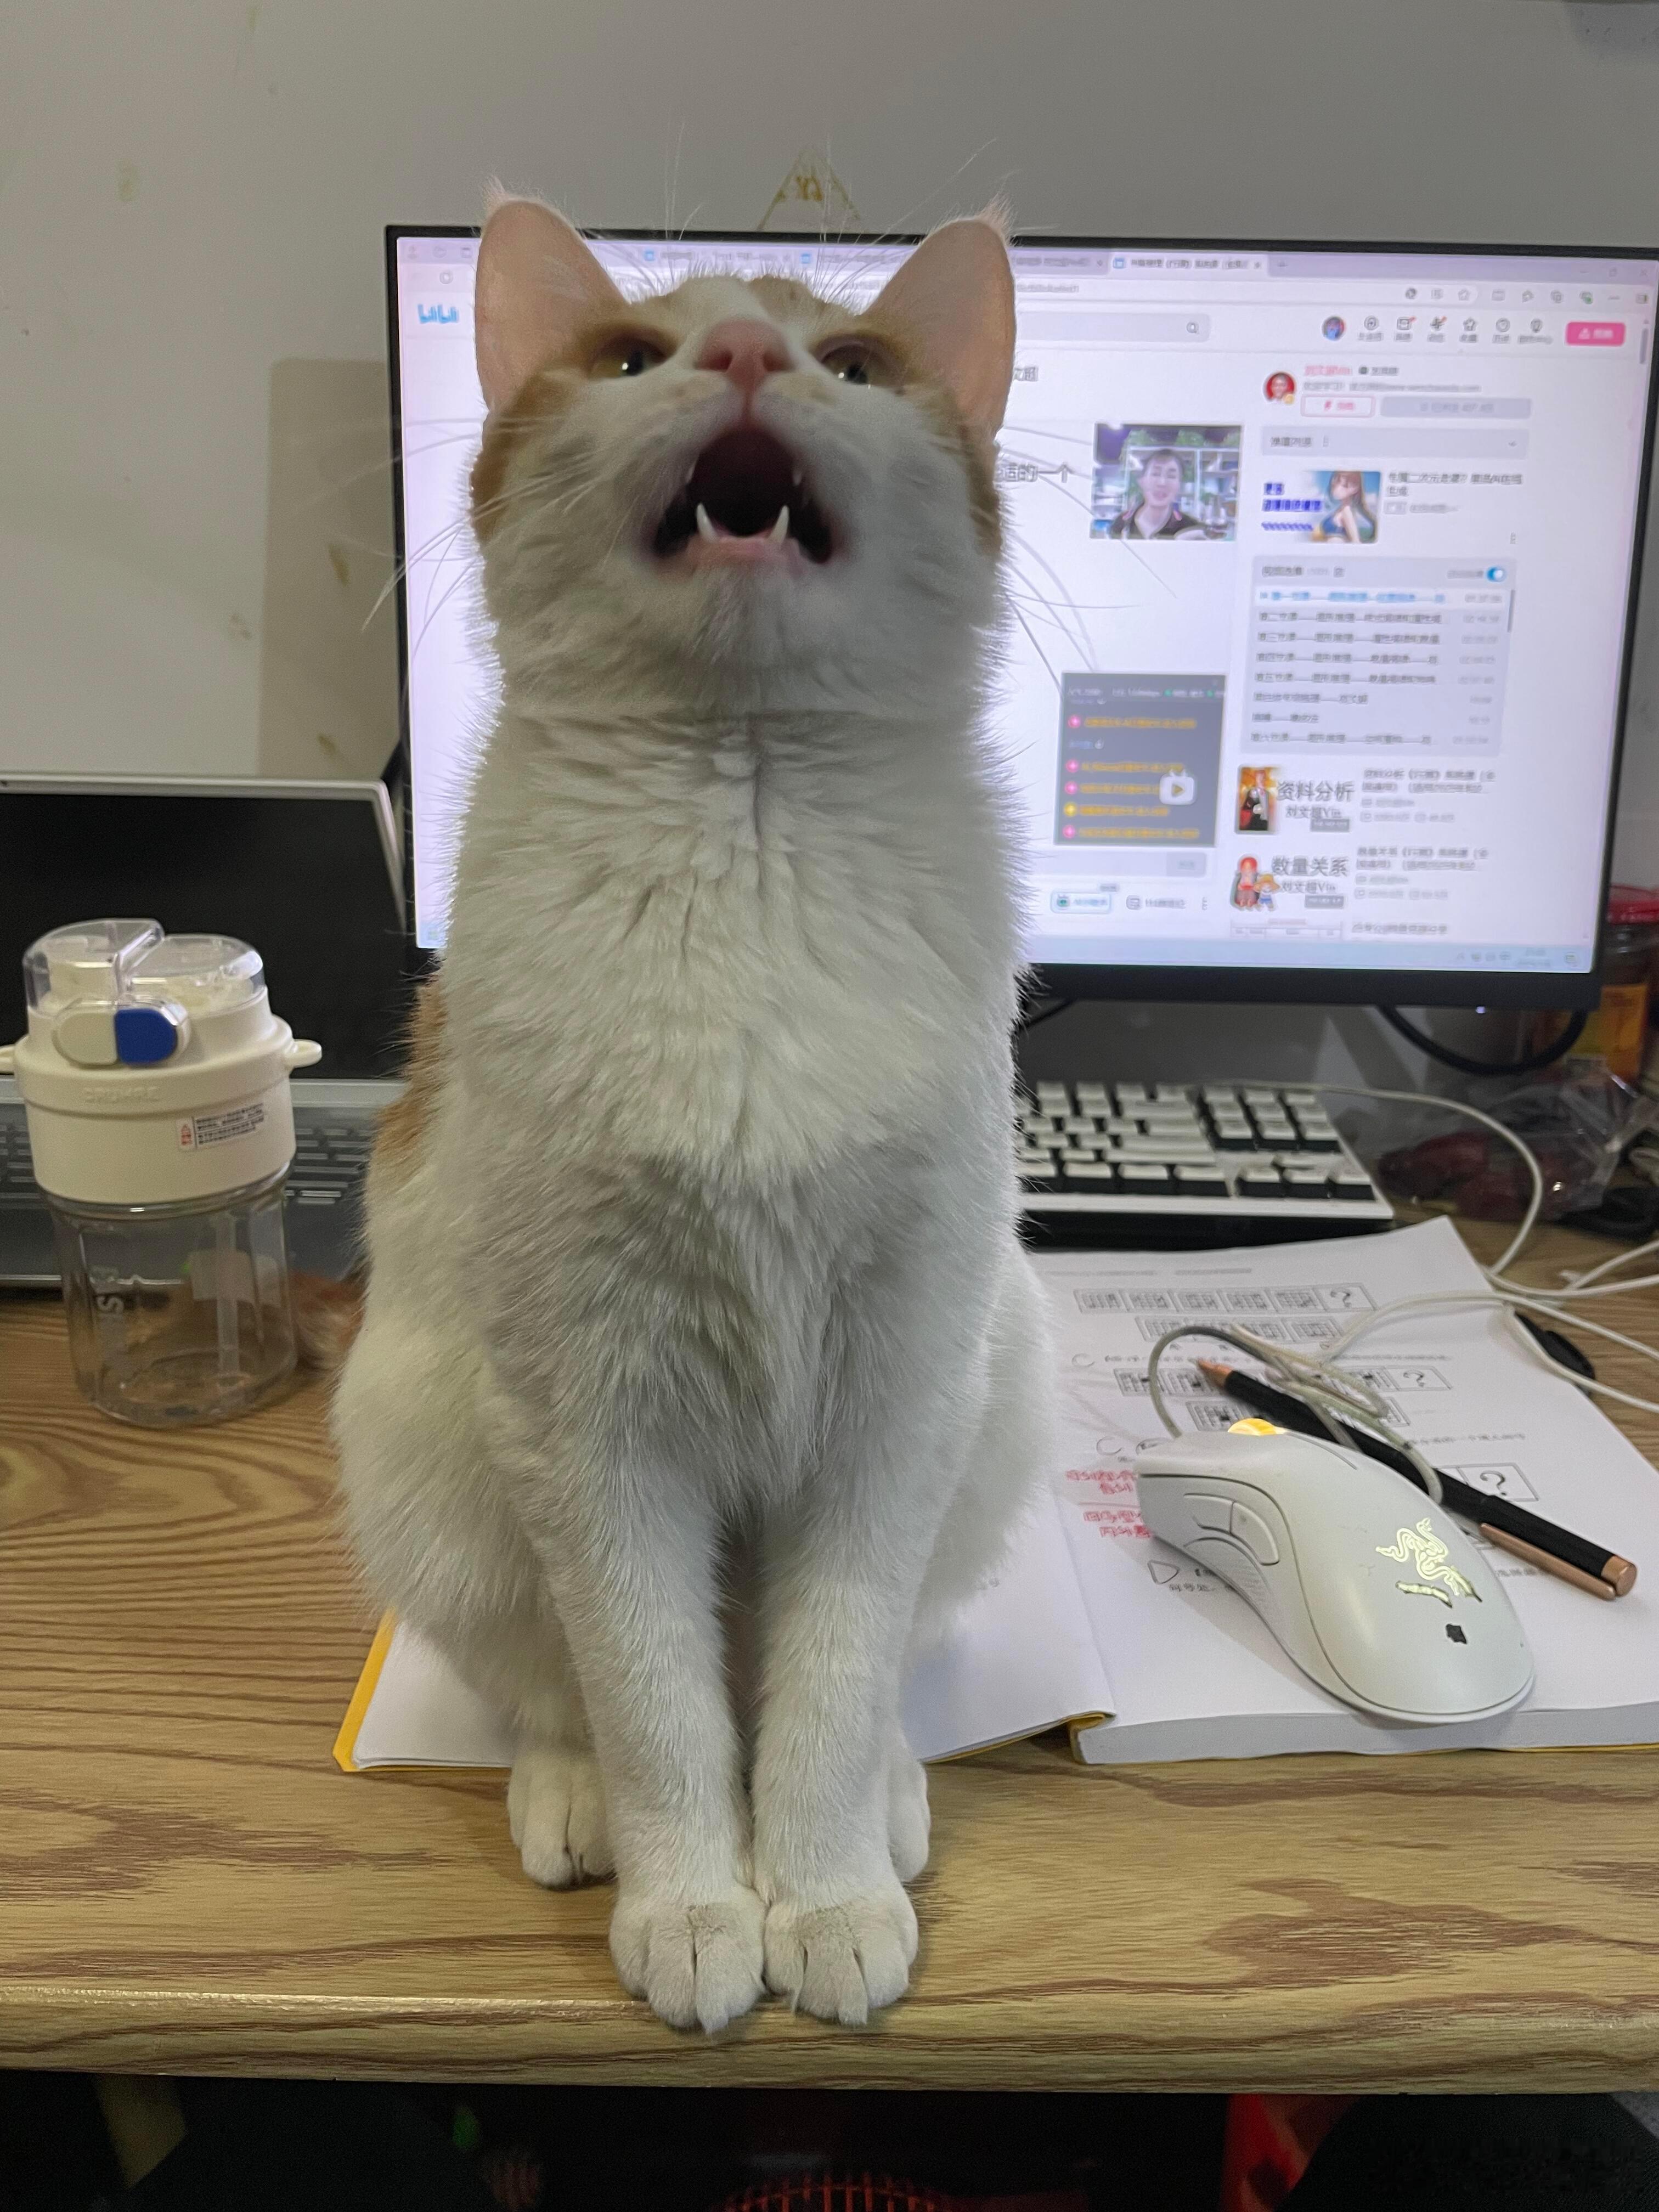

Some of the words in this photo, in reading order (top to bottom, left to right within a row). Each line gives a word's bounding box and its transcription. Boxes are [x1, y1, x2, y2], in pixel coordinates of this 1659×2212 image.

[1277, 780, 1355, 802] 资料分析
[1272, 855, 1349, 877] 数量关系
